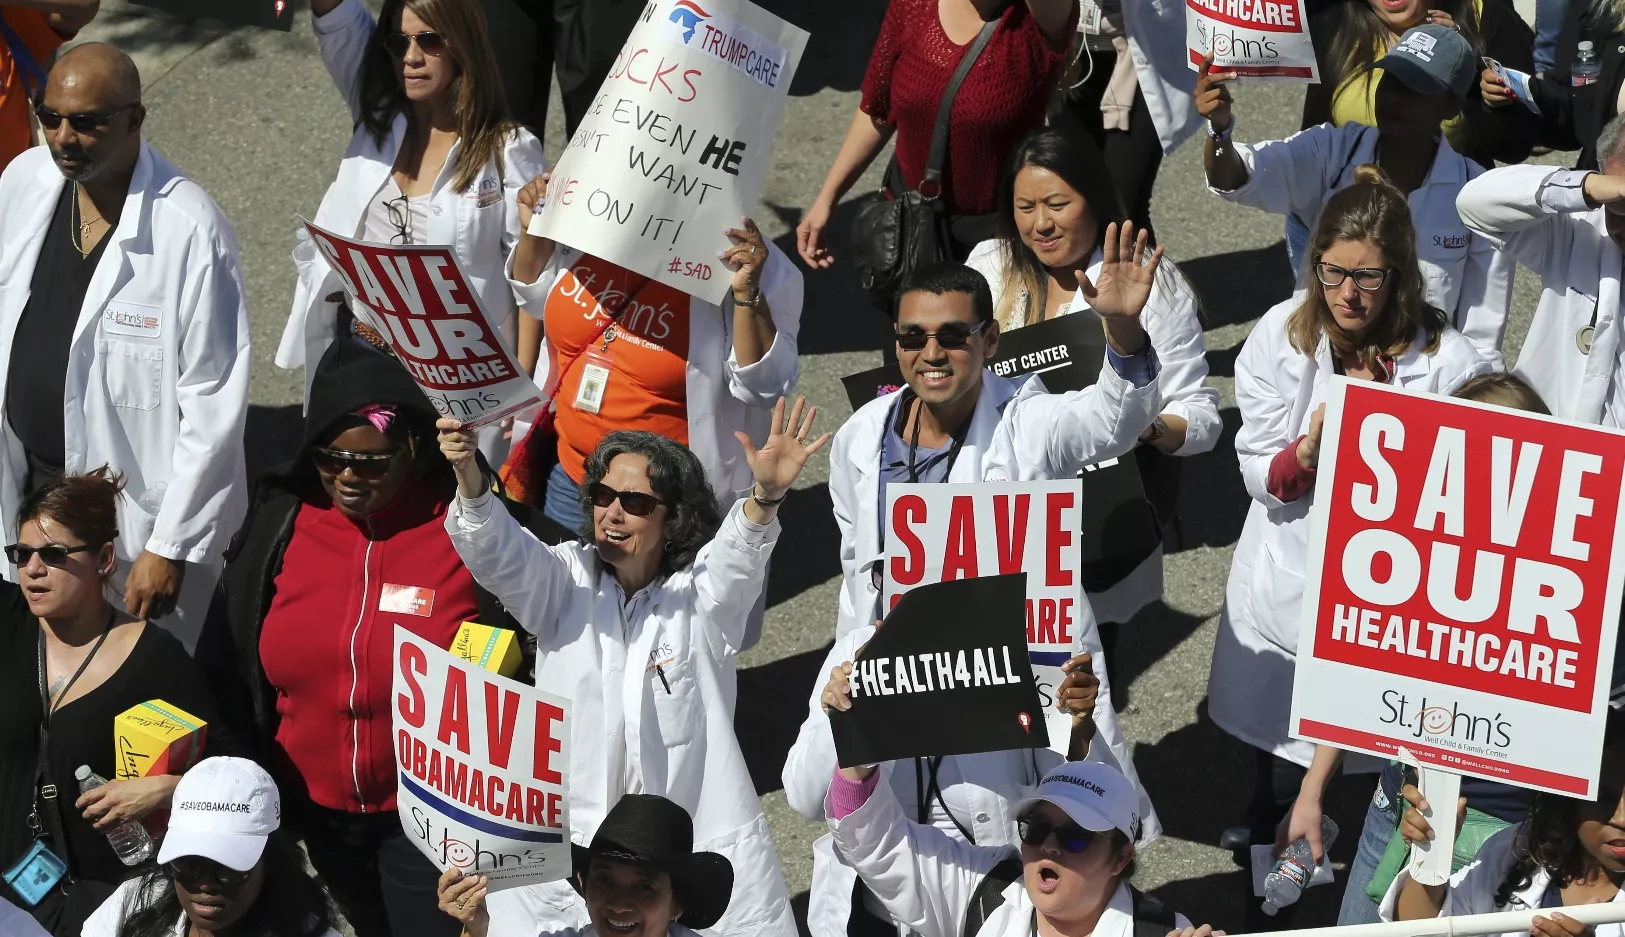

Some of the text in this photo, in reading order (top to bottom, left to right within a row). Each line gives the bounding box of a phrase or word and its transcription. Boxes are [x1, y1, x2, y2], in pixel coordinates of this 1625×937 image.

[701, 25, 780, 88] TRUMPCARE
[612, 98, 697, 156] EVEN
[698, 133, 748, 177] HE
[628, 144, 723, 206] WANT
[587, 188, 634, 225] ON
[641, 214, 685, 251] IT!
[315, 233, 473, 316] SAVE
[560, 266, 597, 308] St.
[668, 256, 713, 281] #SAD
[988, 344, 1070, 377] GBT CENTER
[1350, 412, 1603, 562] SAVE
[890, 492, 1075, 587] SAVE
[1341, 528, 1584, 645] OUR
[849, 646, 1021, 698] #HEALTH4ALL
[1331, 603, 1580, 689] HEALTHCARE
[397, 641, 564, 785] SAVE
[1379, 690, 1512, 748] St. John's
[398, 728, 563, 829] OBAMACARE
[1425, 735, 1439, 744] Well
[1440, 738, 1457, 748] Child
[1464, 743, 1485, 755] Family
[1486, 748, 1509, 759] Center
[180, 801, 251, 814] #SAVEOBAMACARE
[412, 806, 546, 871] St. John's
